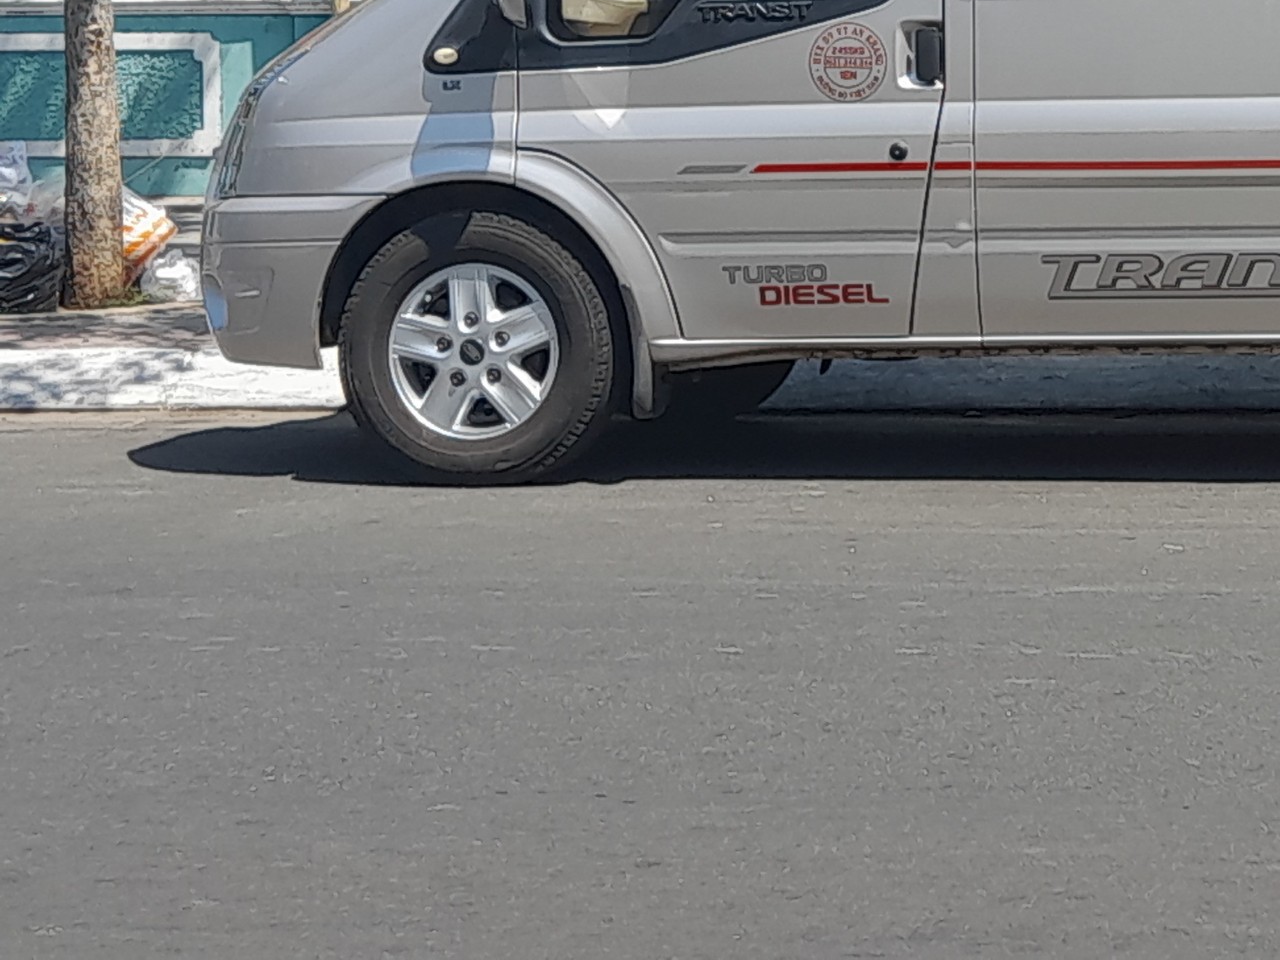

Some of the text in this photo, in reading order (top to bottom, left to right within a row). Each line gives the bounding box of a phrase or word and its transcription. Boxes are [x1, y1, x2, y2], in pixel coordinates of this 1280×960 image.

[697, 0, 813, 24] TRANSIT
[722, 264, 828, 284] TURBO
[759, 283, 890, 306] DIESEL
